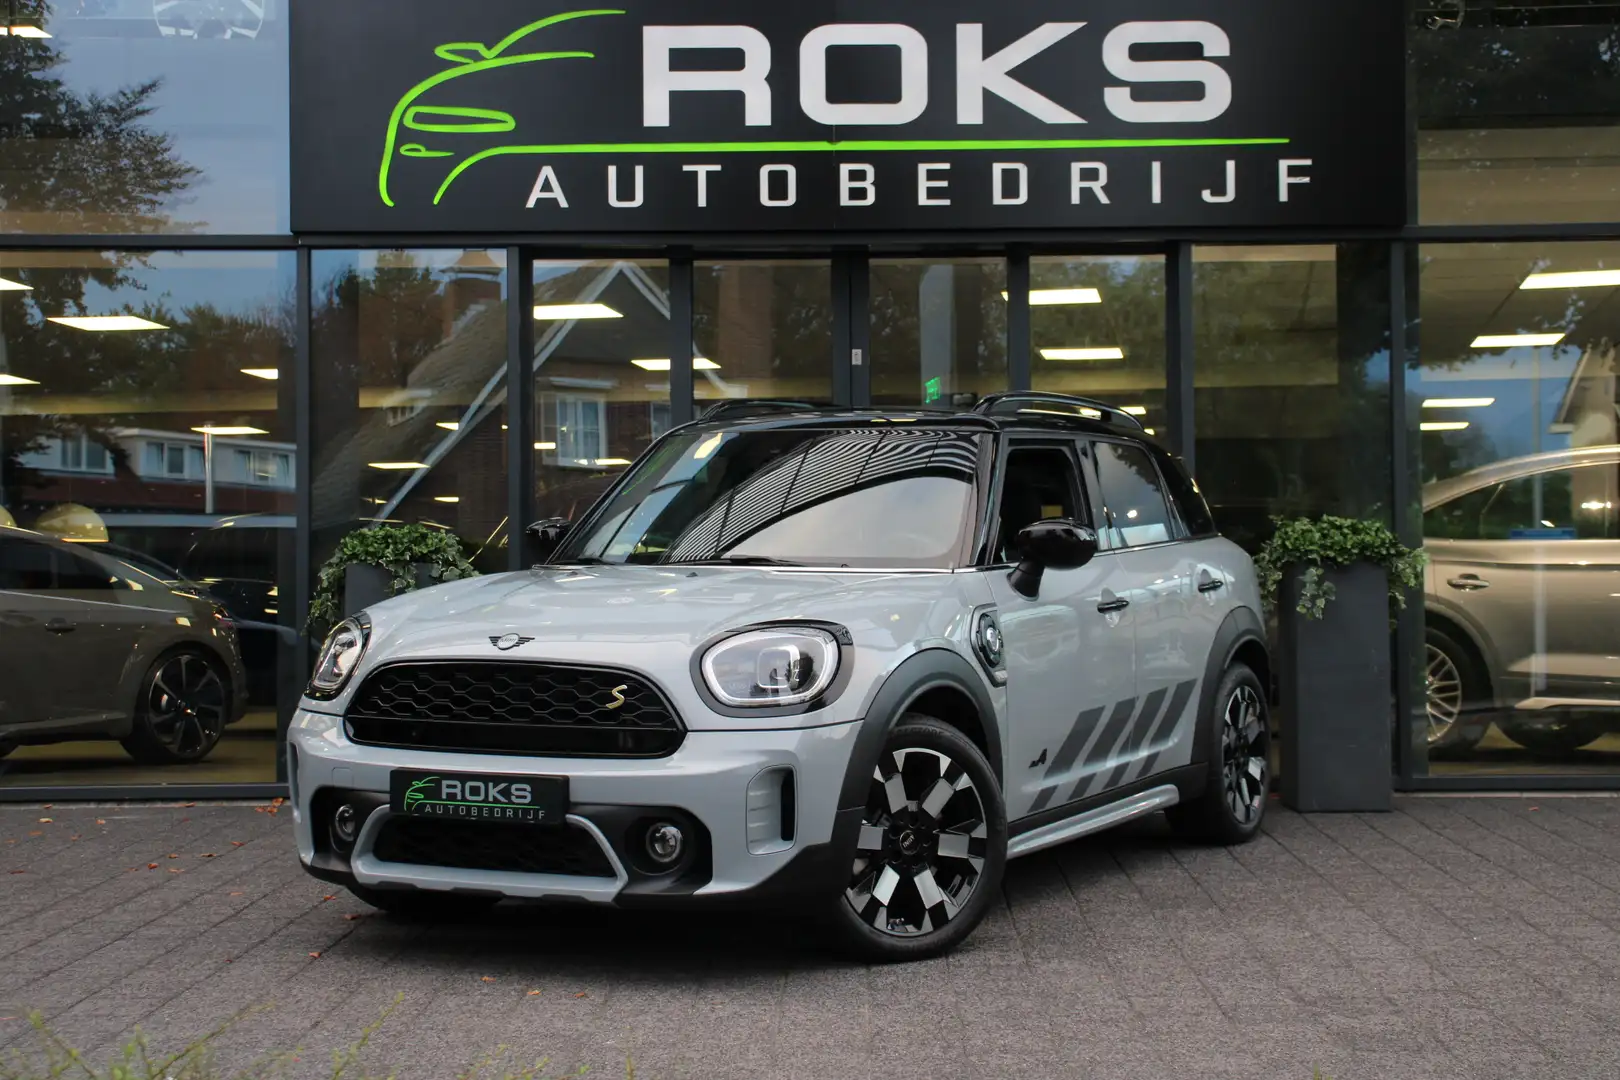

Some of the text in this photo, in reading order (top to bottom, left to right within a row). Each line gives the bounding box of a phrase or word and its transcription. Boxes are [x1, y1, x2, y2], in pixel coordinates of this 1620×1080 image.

[642, 20, 1232, 128] ROKS
[525, 158, 1312, 209] AUTOBEDRIJF
[606, 685, 628, 709] S
[441, 780, 532, 804] ROKS
[424, 804, 545, 820] AUTOBEDRIJF
